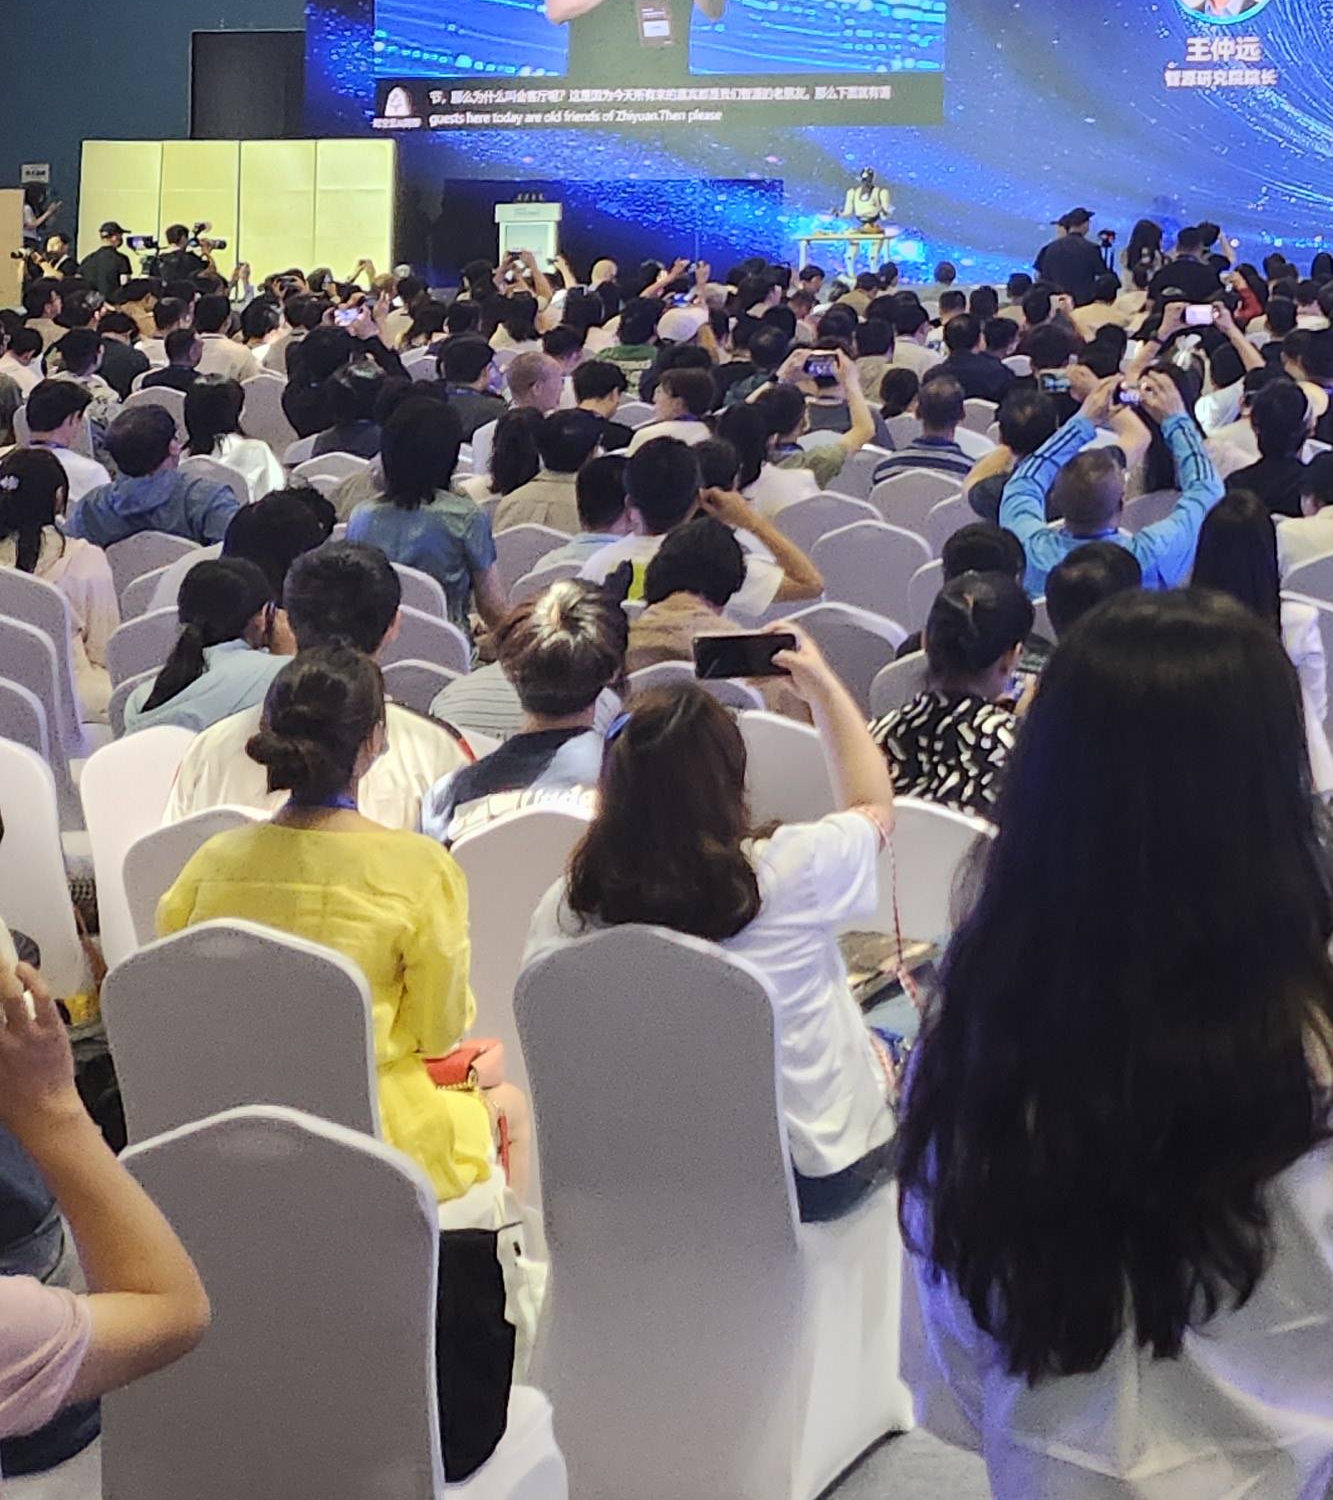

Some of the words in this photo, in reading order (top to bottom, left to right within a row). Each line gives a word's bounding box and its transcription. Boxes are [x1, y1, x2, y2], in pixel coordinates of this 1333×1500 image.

[1186, 35, 1262, 62] 王仲远
[428, 113, 464, 127] guests
[466, 111, 491, 124] here
[492, 111, 523, 125] today
[524, 114, 542, 123] are
[543, 110, 562, 123] old
[563, 109, 599, 122] friends
[601, 109, 614, 122] of
[688, 107, 723, 123] please
